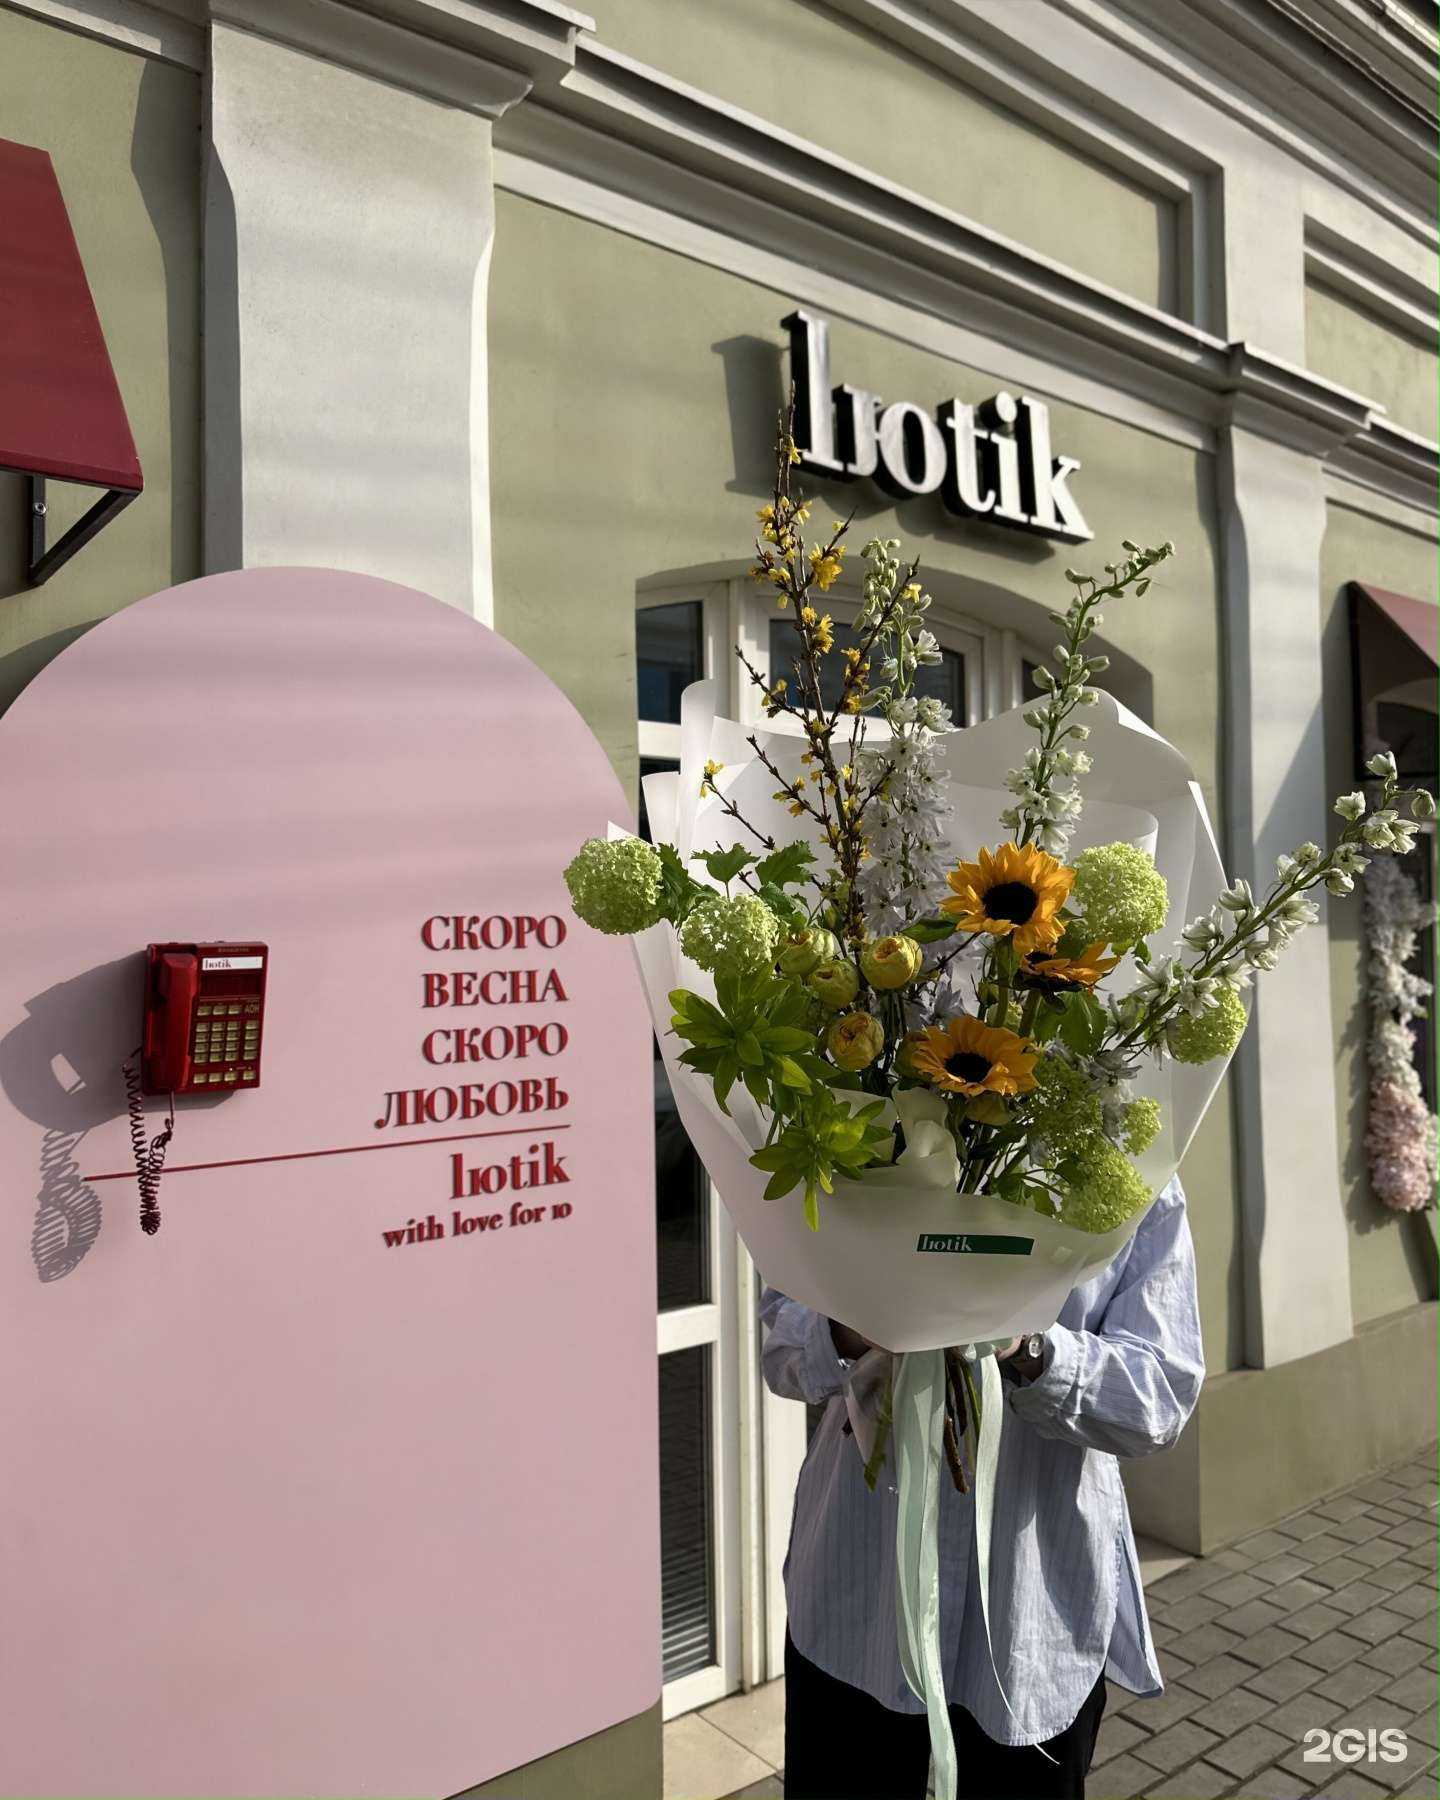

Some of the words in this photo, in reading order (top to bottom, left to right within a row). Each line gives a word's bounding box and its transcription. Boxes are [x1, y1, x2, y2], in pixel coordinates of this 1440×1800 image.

[420, 914, 567, 952] СКОРО
[421, 967, 570, 1009] ВЕСНА
[421, 1022, 569, 1065] СКОРО
[373, 1076, 570, 1130] ЛЮБОВЬ
[382, 1214, 445, 1249] with
[452, 1210, 504, 1238] love
[509, 1201, 546, 1228] for
